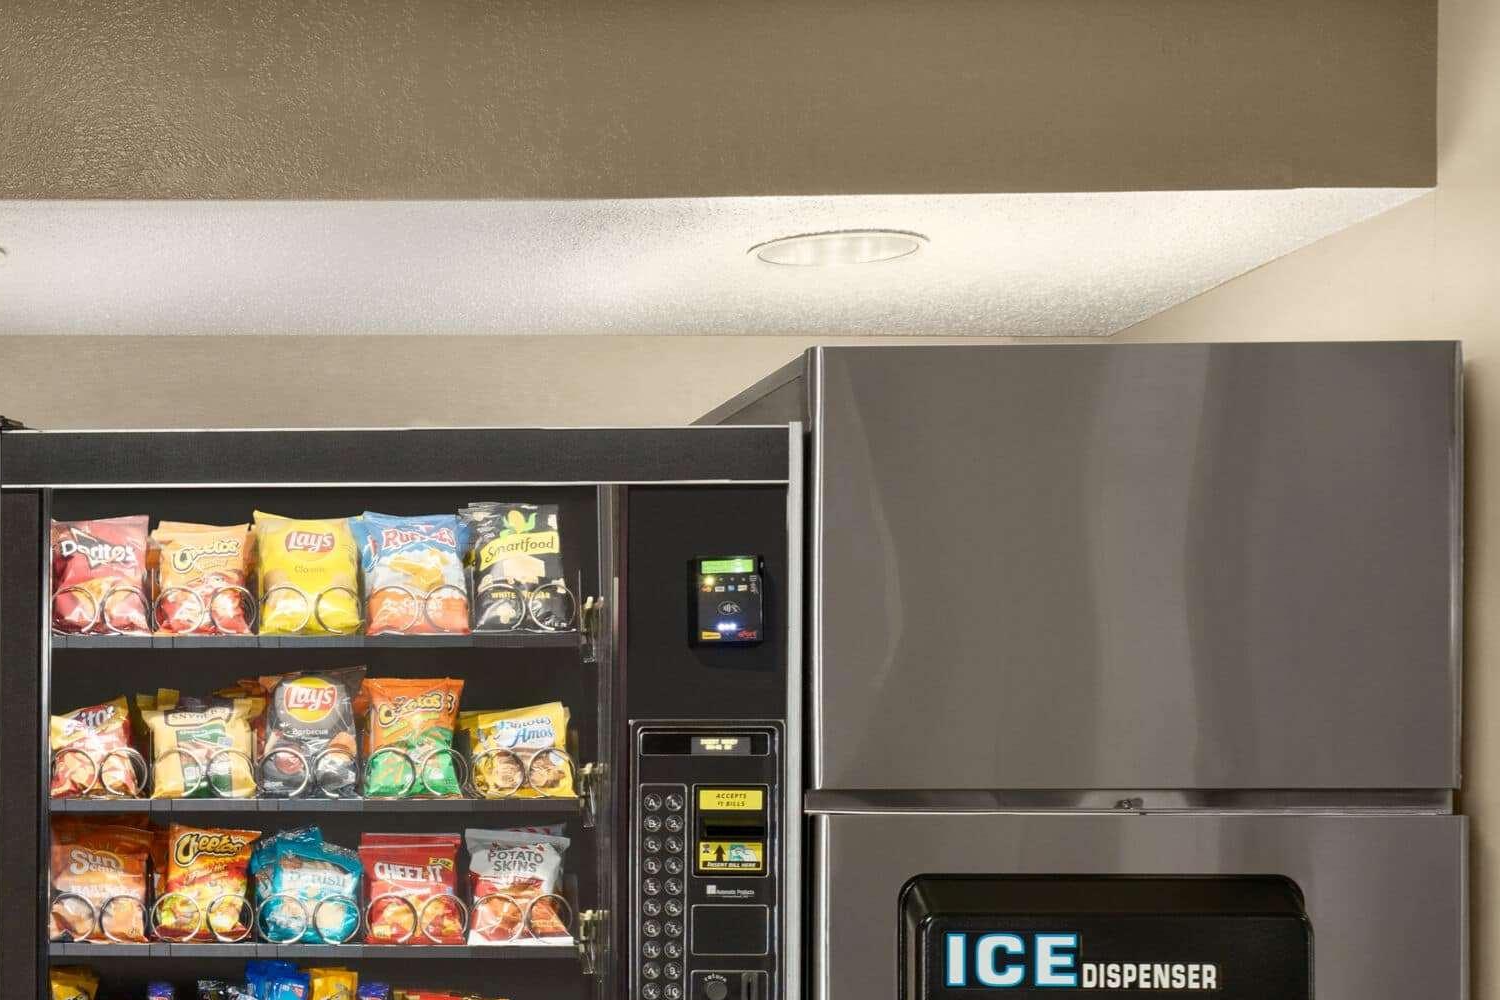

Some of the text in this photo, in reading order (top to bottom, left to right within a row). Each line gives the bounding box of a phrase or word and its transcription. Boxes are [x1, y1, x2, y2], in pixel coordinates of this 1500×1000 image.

[484, 535, 554, 563] Smartfood
[507, 728, 554, 748] Amos
[488, 850, 544, 863] POTATO
[493, 860, 537, 873] SKINS
[946, 933, 1217, 989] ICE DISPENSER
